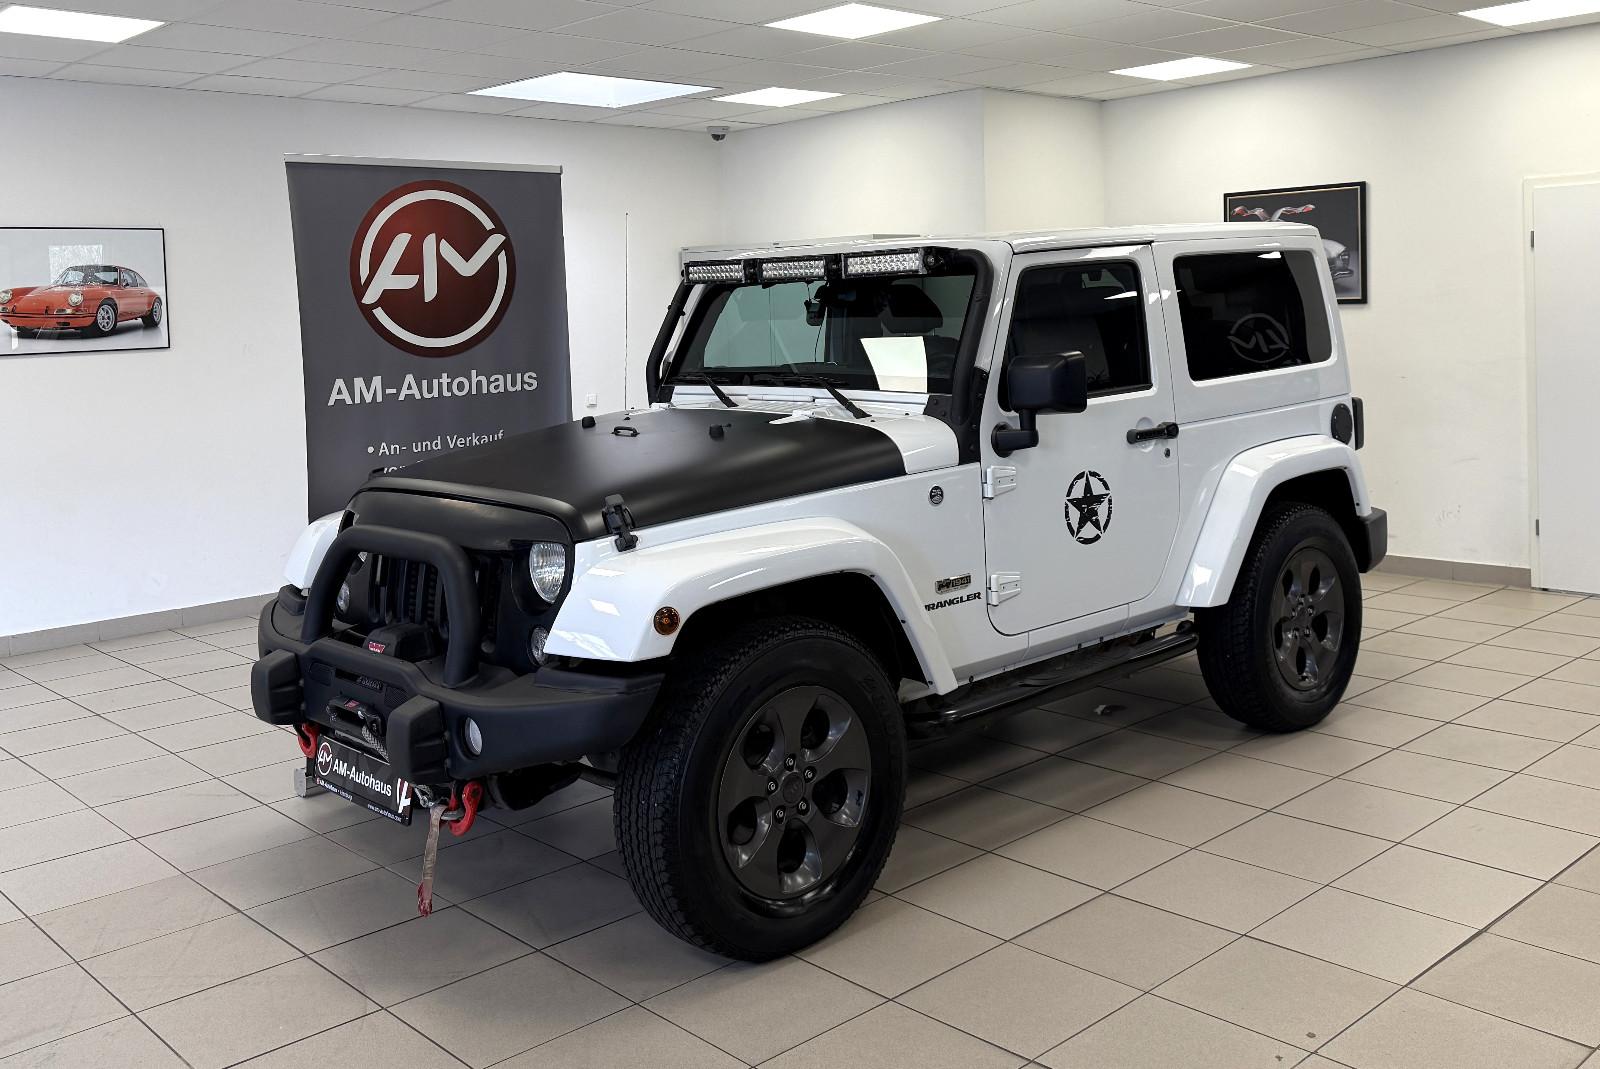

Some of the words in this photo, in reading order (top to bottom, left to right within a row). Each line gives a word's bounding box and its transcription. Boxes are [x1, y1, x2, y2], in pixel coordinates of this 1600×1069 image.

[328, 369, 538, 406] AM-Autohaus
[378, 442, 407, 456] An-
[412, 435, 442, 453] und
[332, 757, 392, 797] AM-Autohaus
